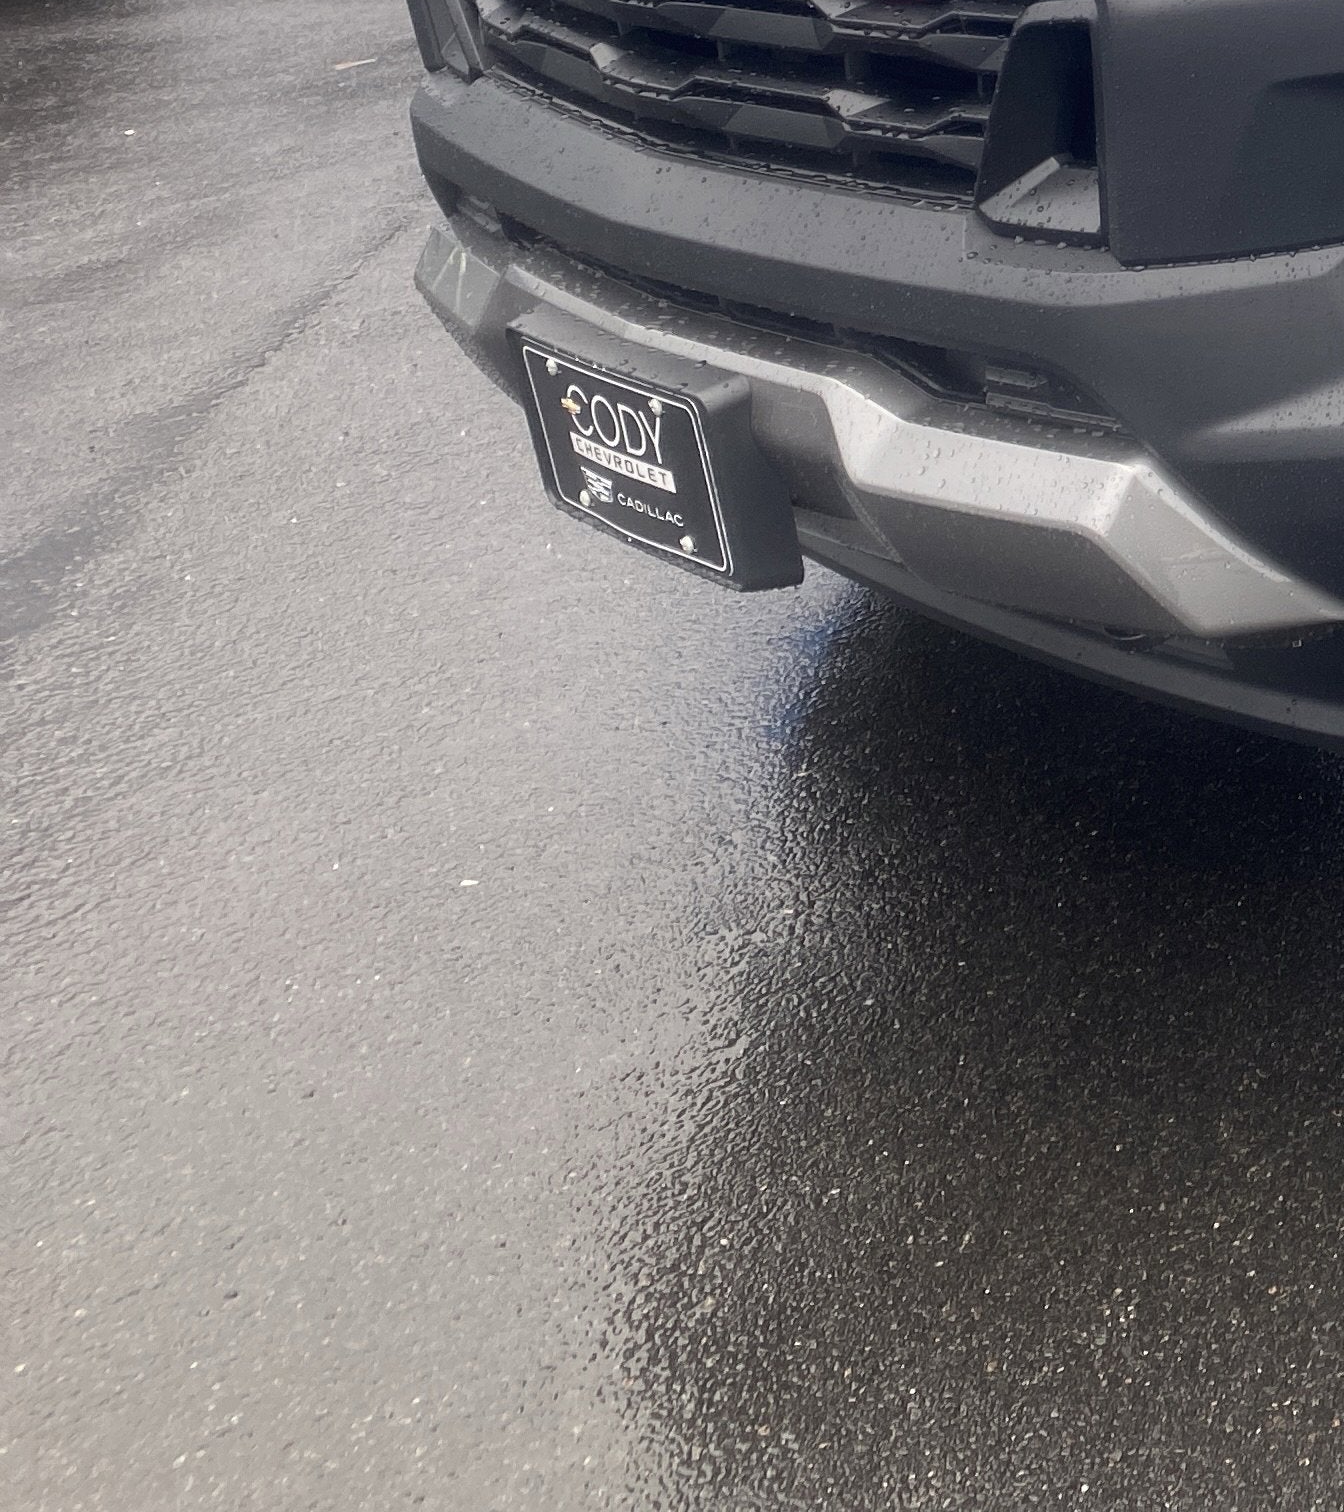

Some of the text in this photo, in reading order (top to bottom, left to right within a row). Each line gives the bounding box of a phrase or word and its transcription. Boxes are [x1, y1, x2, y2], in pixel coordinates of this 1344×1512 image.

[564, 384, 663, 464] CODY
[574, 437, 669, 487] CHEVROLET
[616, 493, 684, 527] CADILLAC
